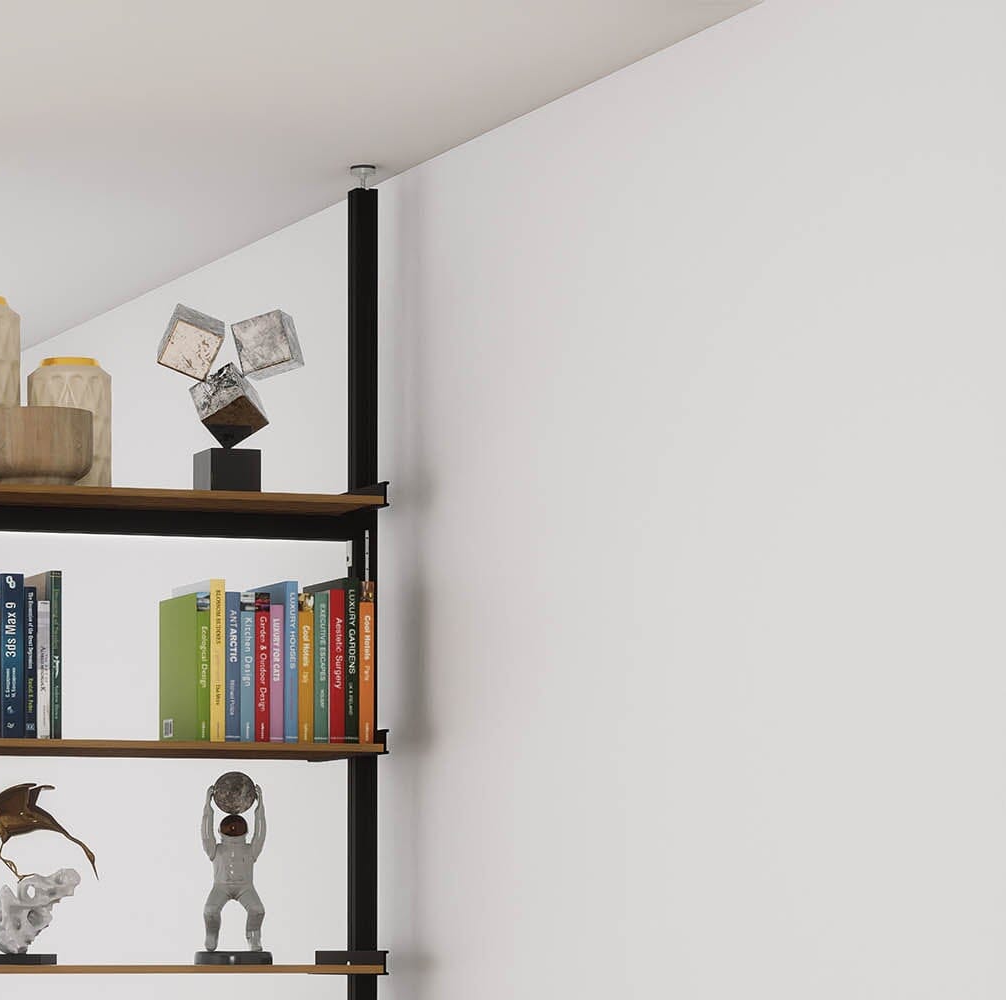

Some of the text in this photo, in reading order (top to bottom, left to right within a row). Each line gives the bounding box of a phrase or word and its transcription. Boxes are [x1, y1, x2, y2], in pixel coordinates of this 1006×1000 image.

[5, 612, 17, 635] Max
[348, 589, 356, 625] LUXURY
[5, 638, 17, 658] 3ds
[272, 618, 280, 682] LUXURY FOR CATS
[302, 625, 310, 642] Cool
[200, 626, 208, 688] Ecological Design
[243, 617, 253, 687] Kitchen Design
[302, 643, 310, 667] Hotels
[348, 628, 356, 675] GARDENS
[334, 655, 342, 689] Surgery
[258, 687, 267, 712] Design
